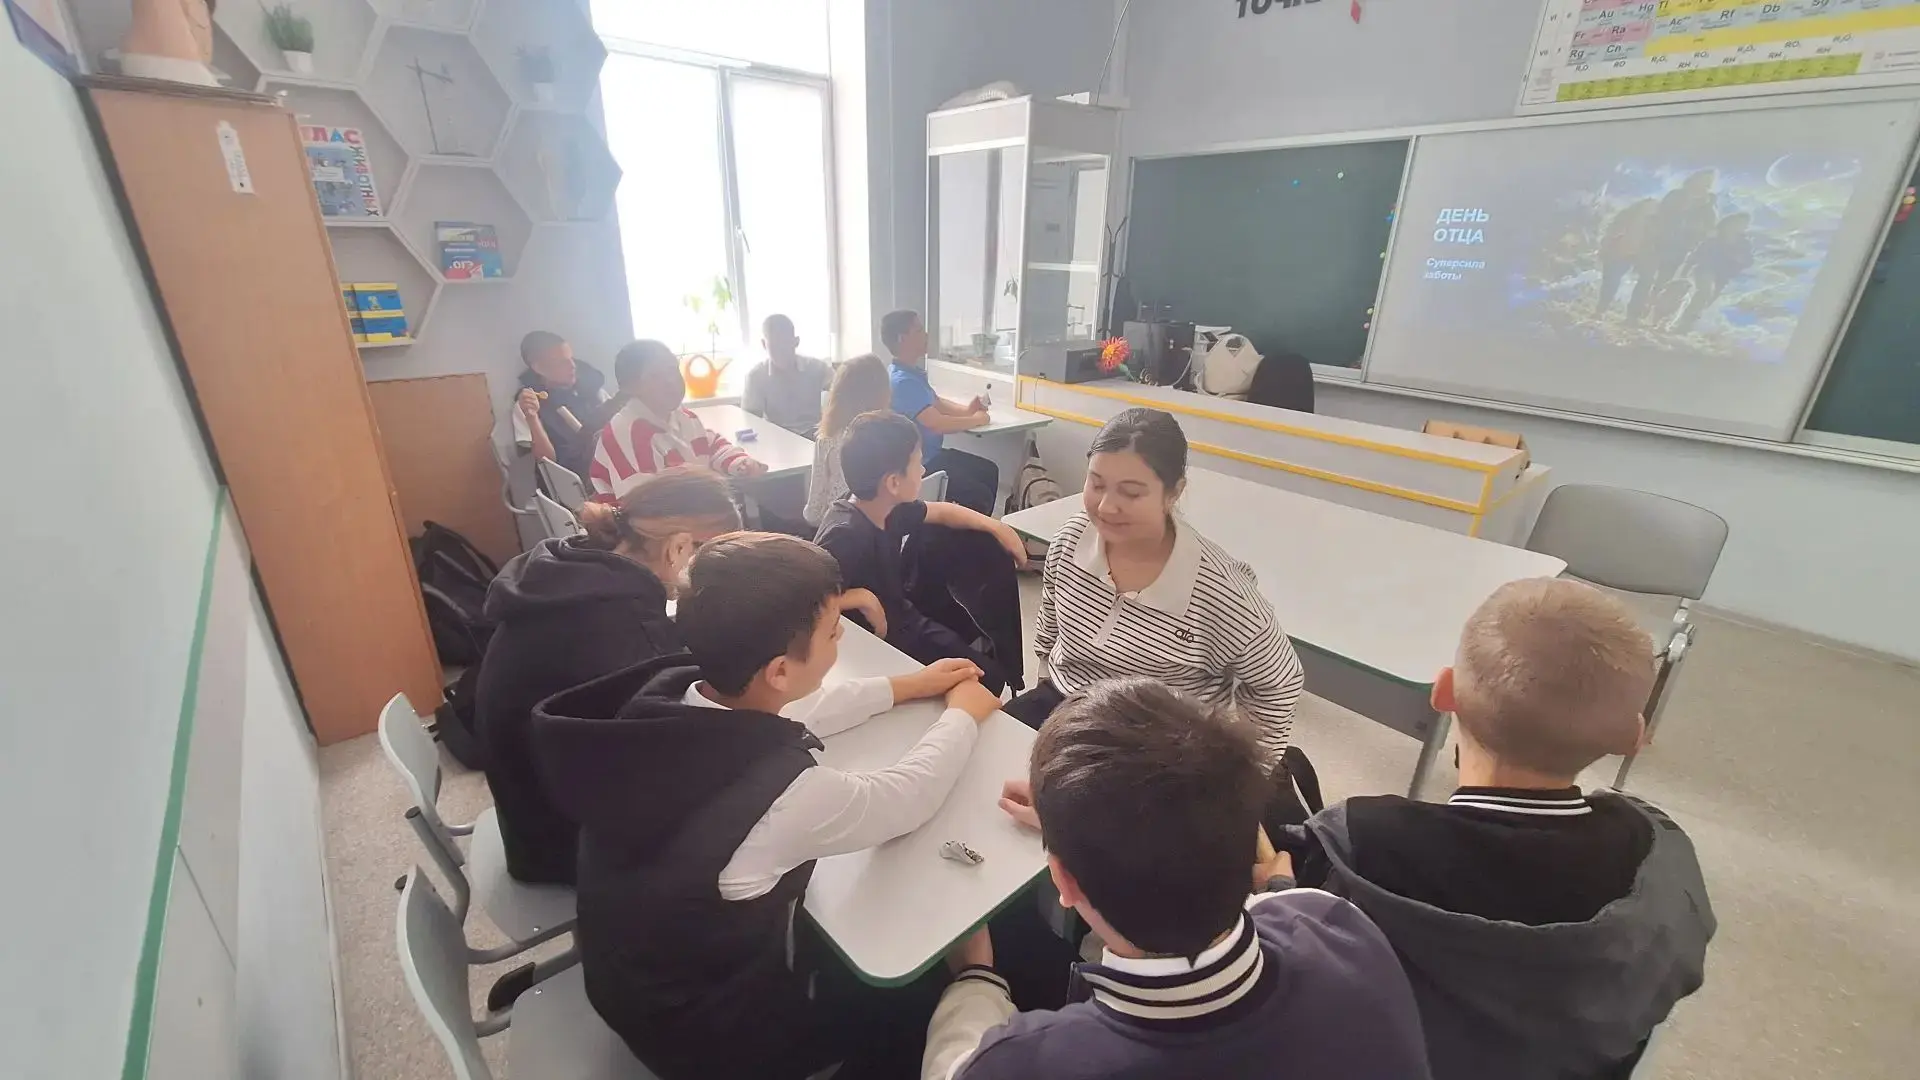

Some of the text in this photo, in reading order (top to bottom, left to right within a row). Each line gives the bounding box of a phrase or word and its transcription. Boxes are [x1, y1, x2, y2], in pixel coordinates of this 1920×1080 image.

[1599, 10, 1615, 19] Au
[1638, 3, 1655, 13] Hg
[1762, 4, 1781, 14] Db
[1611, 25, 1626, 34] Ra
[1569, 49, 1585, 59] Rg
[1606, 44, 1622, 53] Cn
[1436, 207, 1490, 224] ДЕНЬ
[1433, 228, 1484, 245] ОТЦА
[1426, 257, 1486, 269] Суперсила
